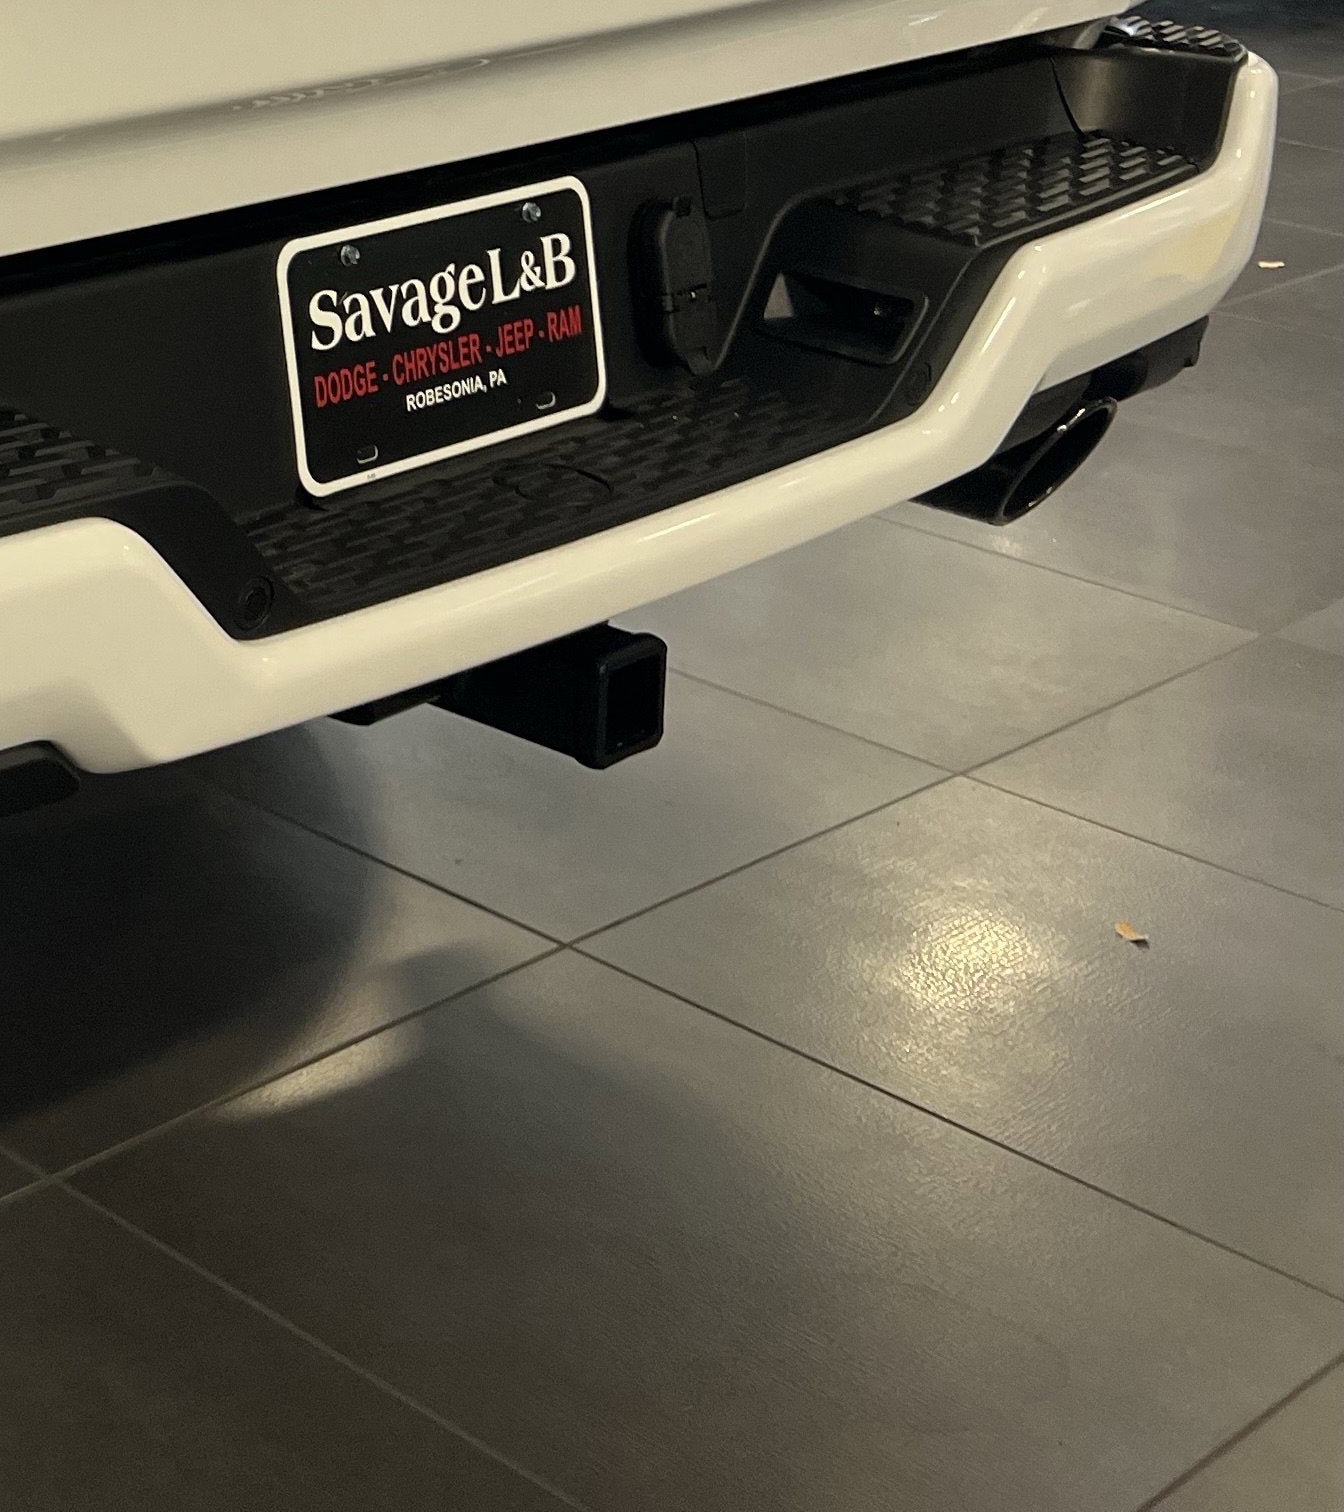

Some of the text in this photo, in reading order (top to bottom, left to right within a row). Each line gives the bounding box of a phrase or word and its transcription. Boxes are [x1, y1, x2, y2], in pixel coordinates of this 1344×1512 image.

[313, 304, 583, 408] DODGE CHRYSLER JEEP RAM
[406, 368, 508, 412] ROBESONIA, PA
